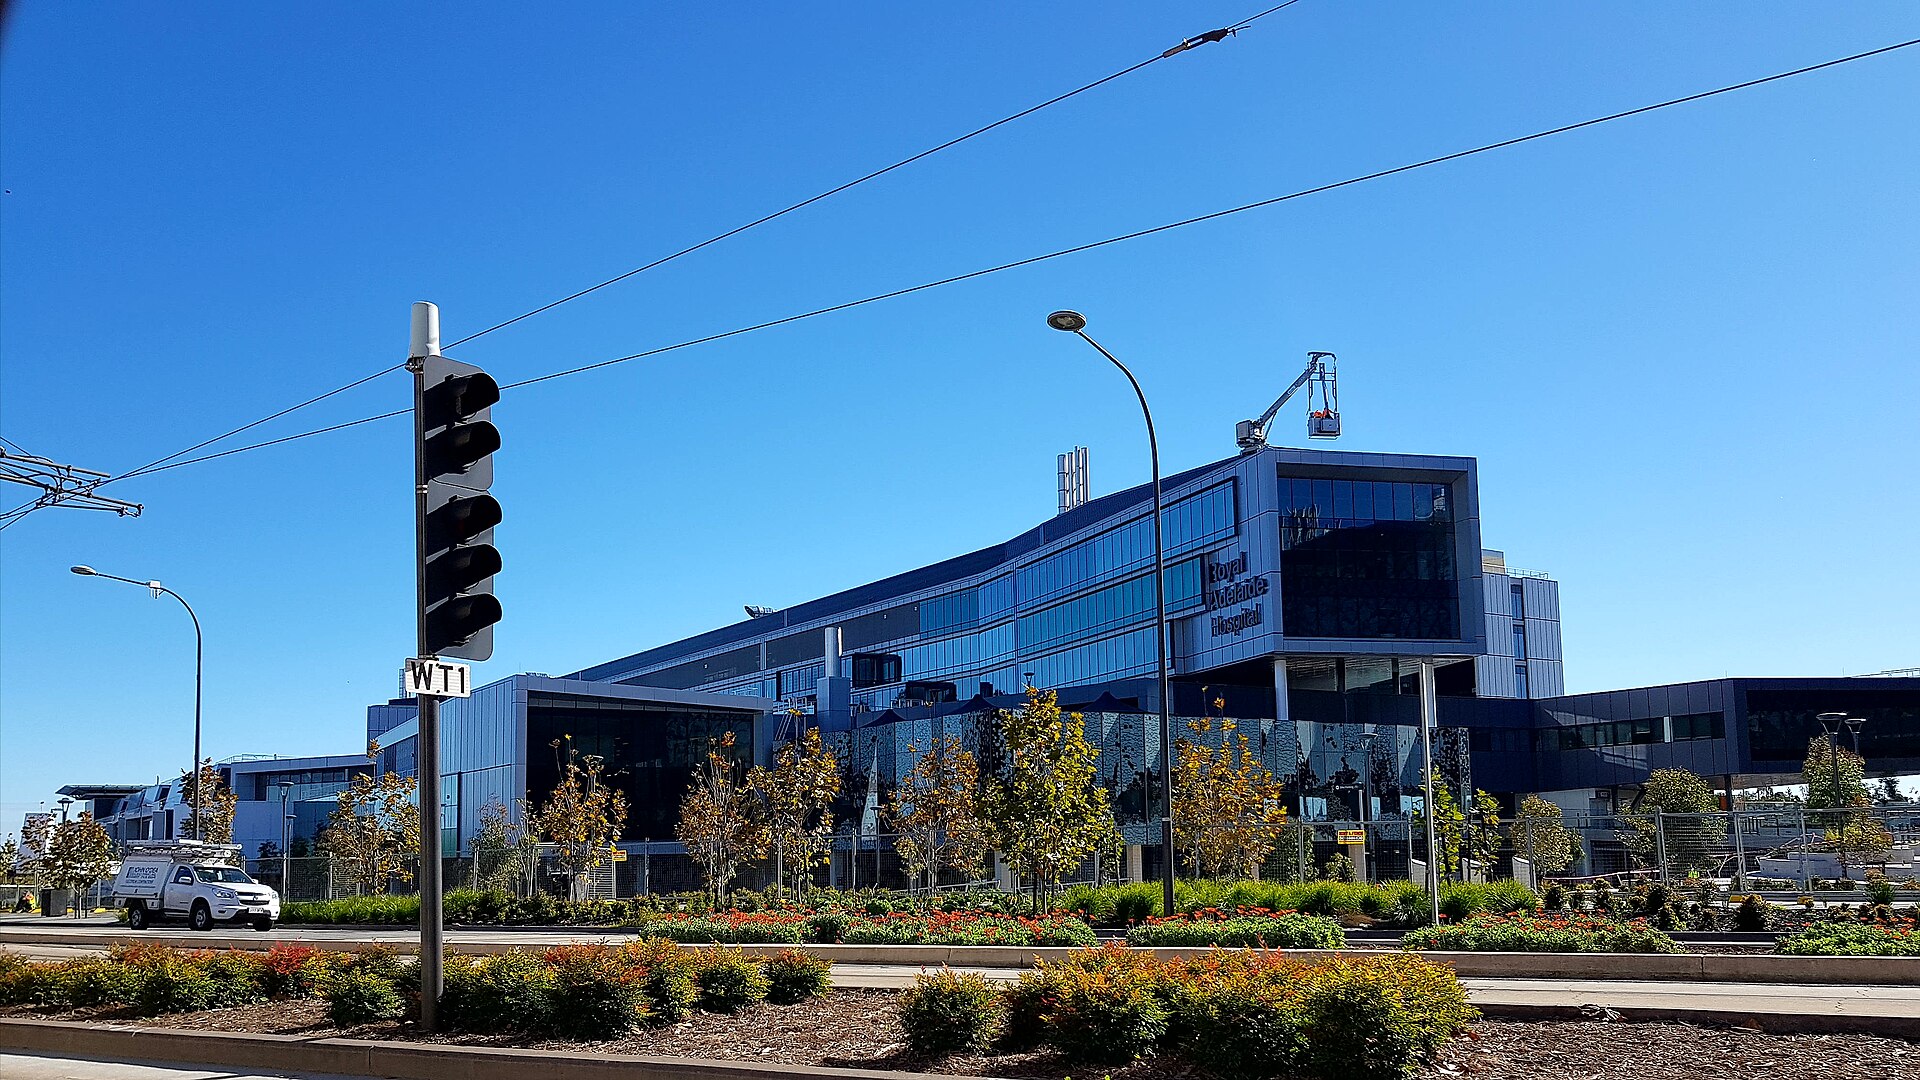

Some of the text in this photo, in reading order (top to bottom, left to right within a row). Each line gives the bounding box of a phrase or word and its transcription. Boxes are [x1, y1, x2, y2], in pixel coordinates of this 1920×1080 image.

[1209, 551, 1248, 583] Royal
[1211, 576, 1269, 611] Adelaide
[1211, 602, 1262, 637] Hospital
